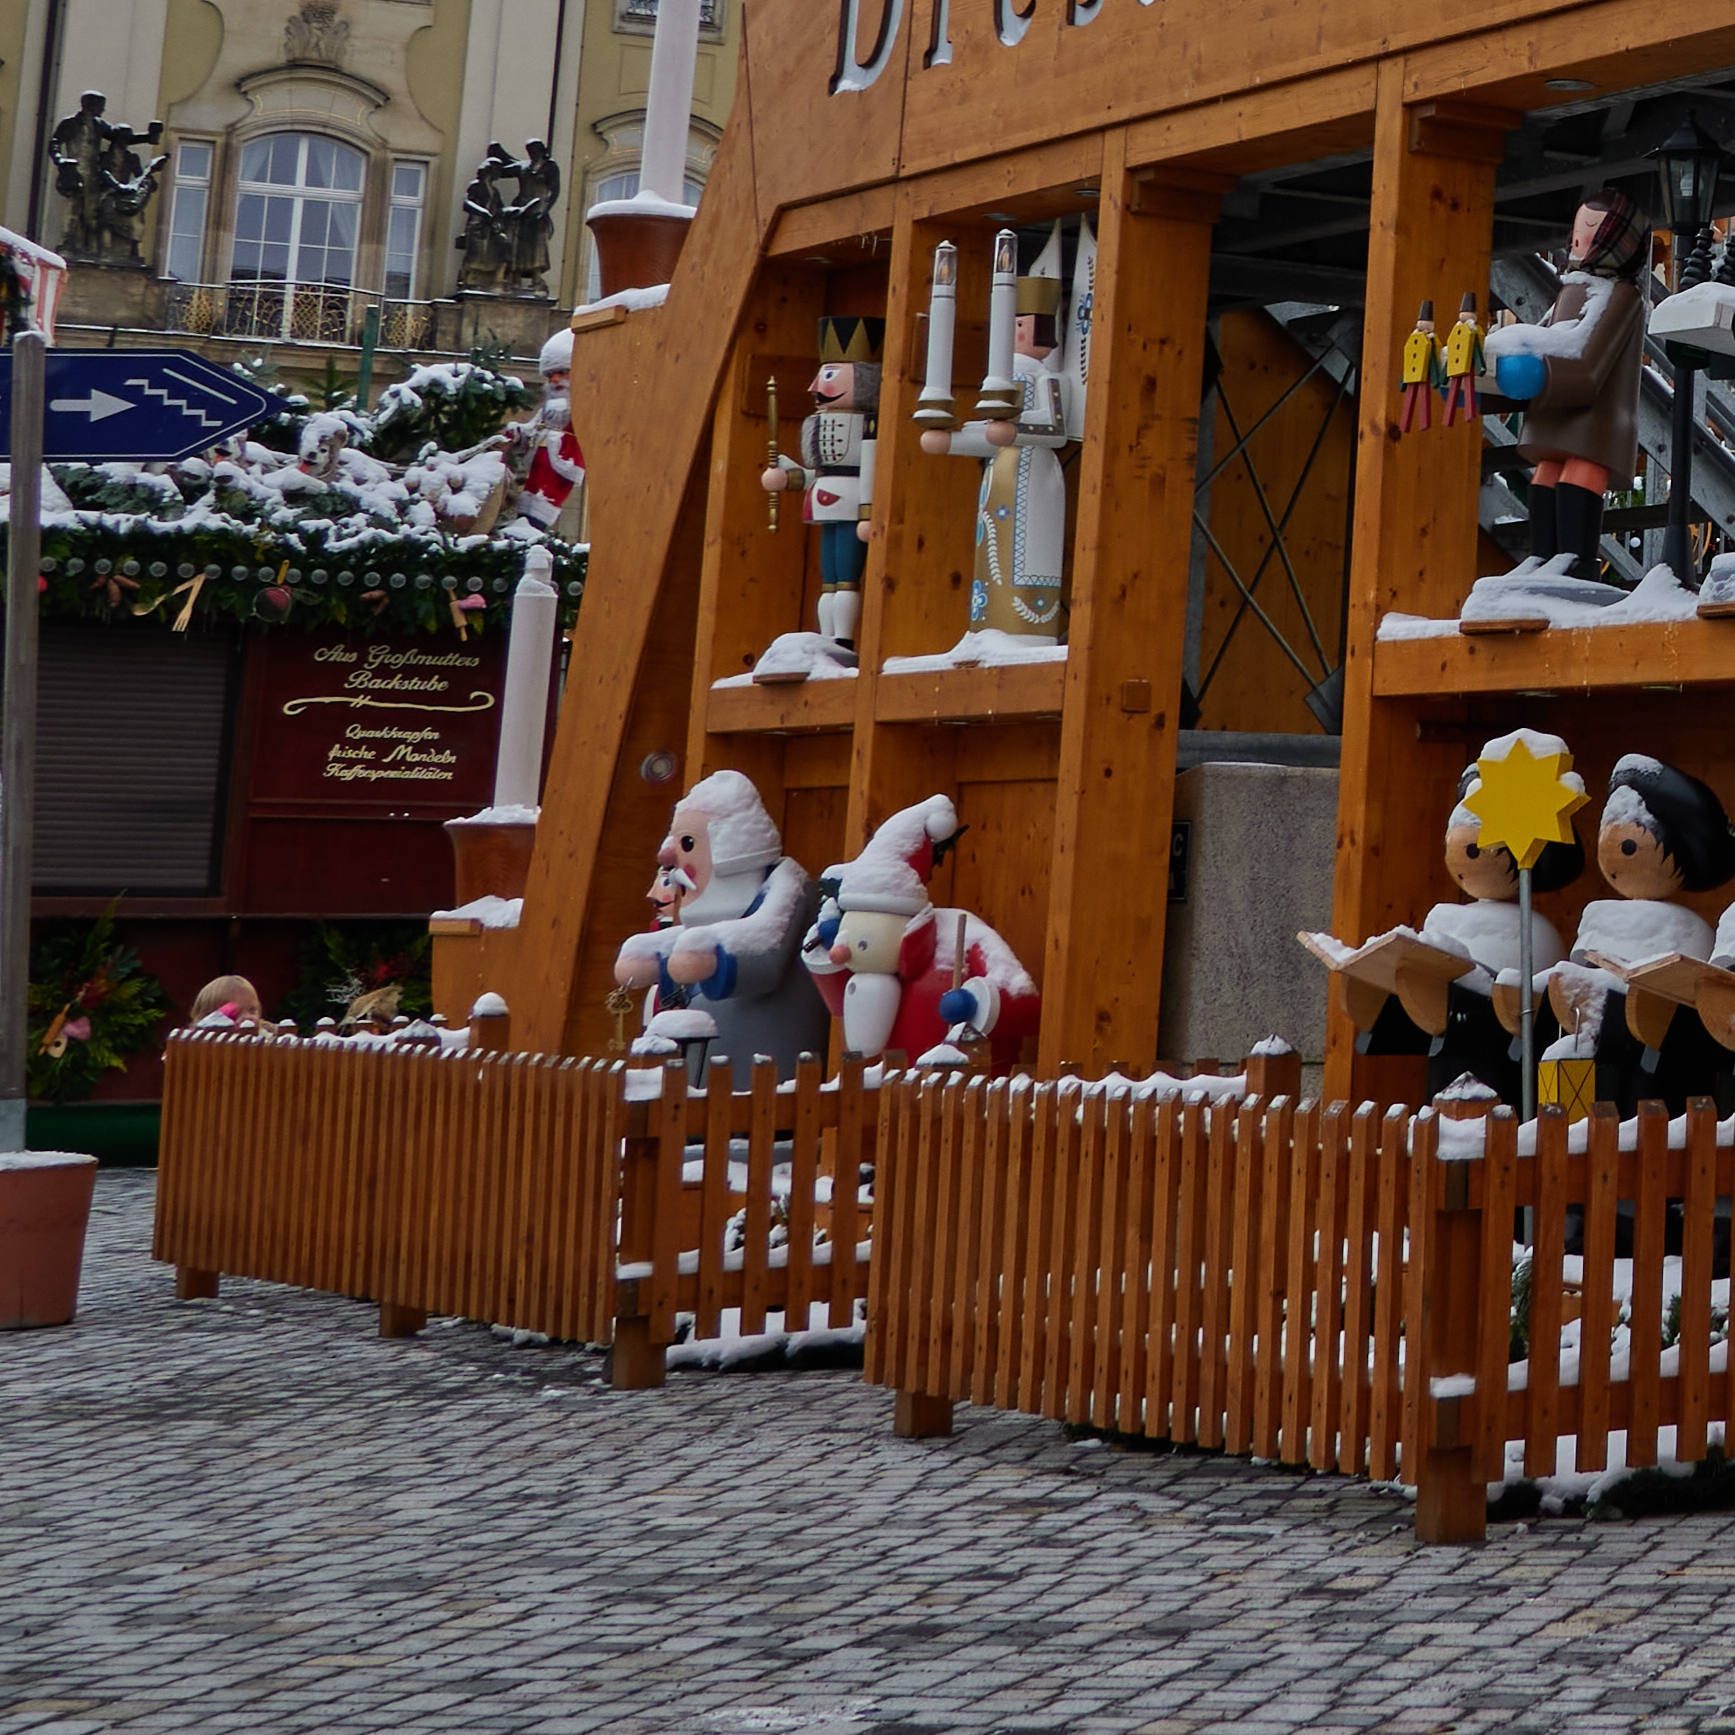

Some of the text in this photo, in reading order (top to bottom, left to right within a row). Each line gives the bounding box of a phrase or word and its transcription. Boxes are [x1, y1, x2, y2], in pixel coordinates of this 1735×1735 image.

[313, 644, 480, 669] Aus Großmutters
[344, 670, 449, 690] Backstube
[345, 723, 441, 743] Quarkkrapfen
[327, 743, 457, 763] frische Mandeln
[322, 762, 454, 782] Kaffeespezialitäten
